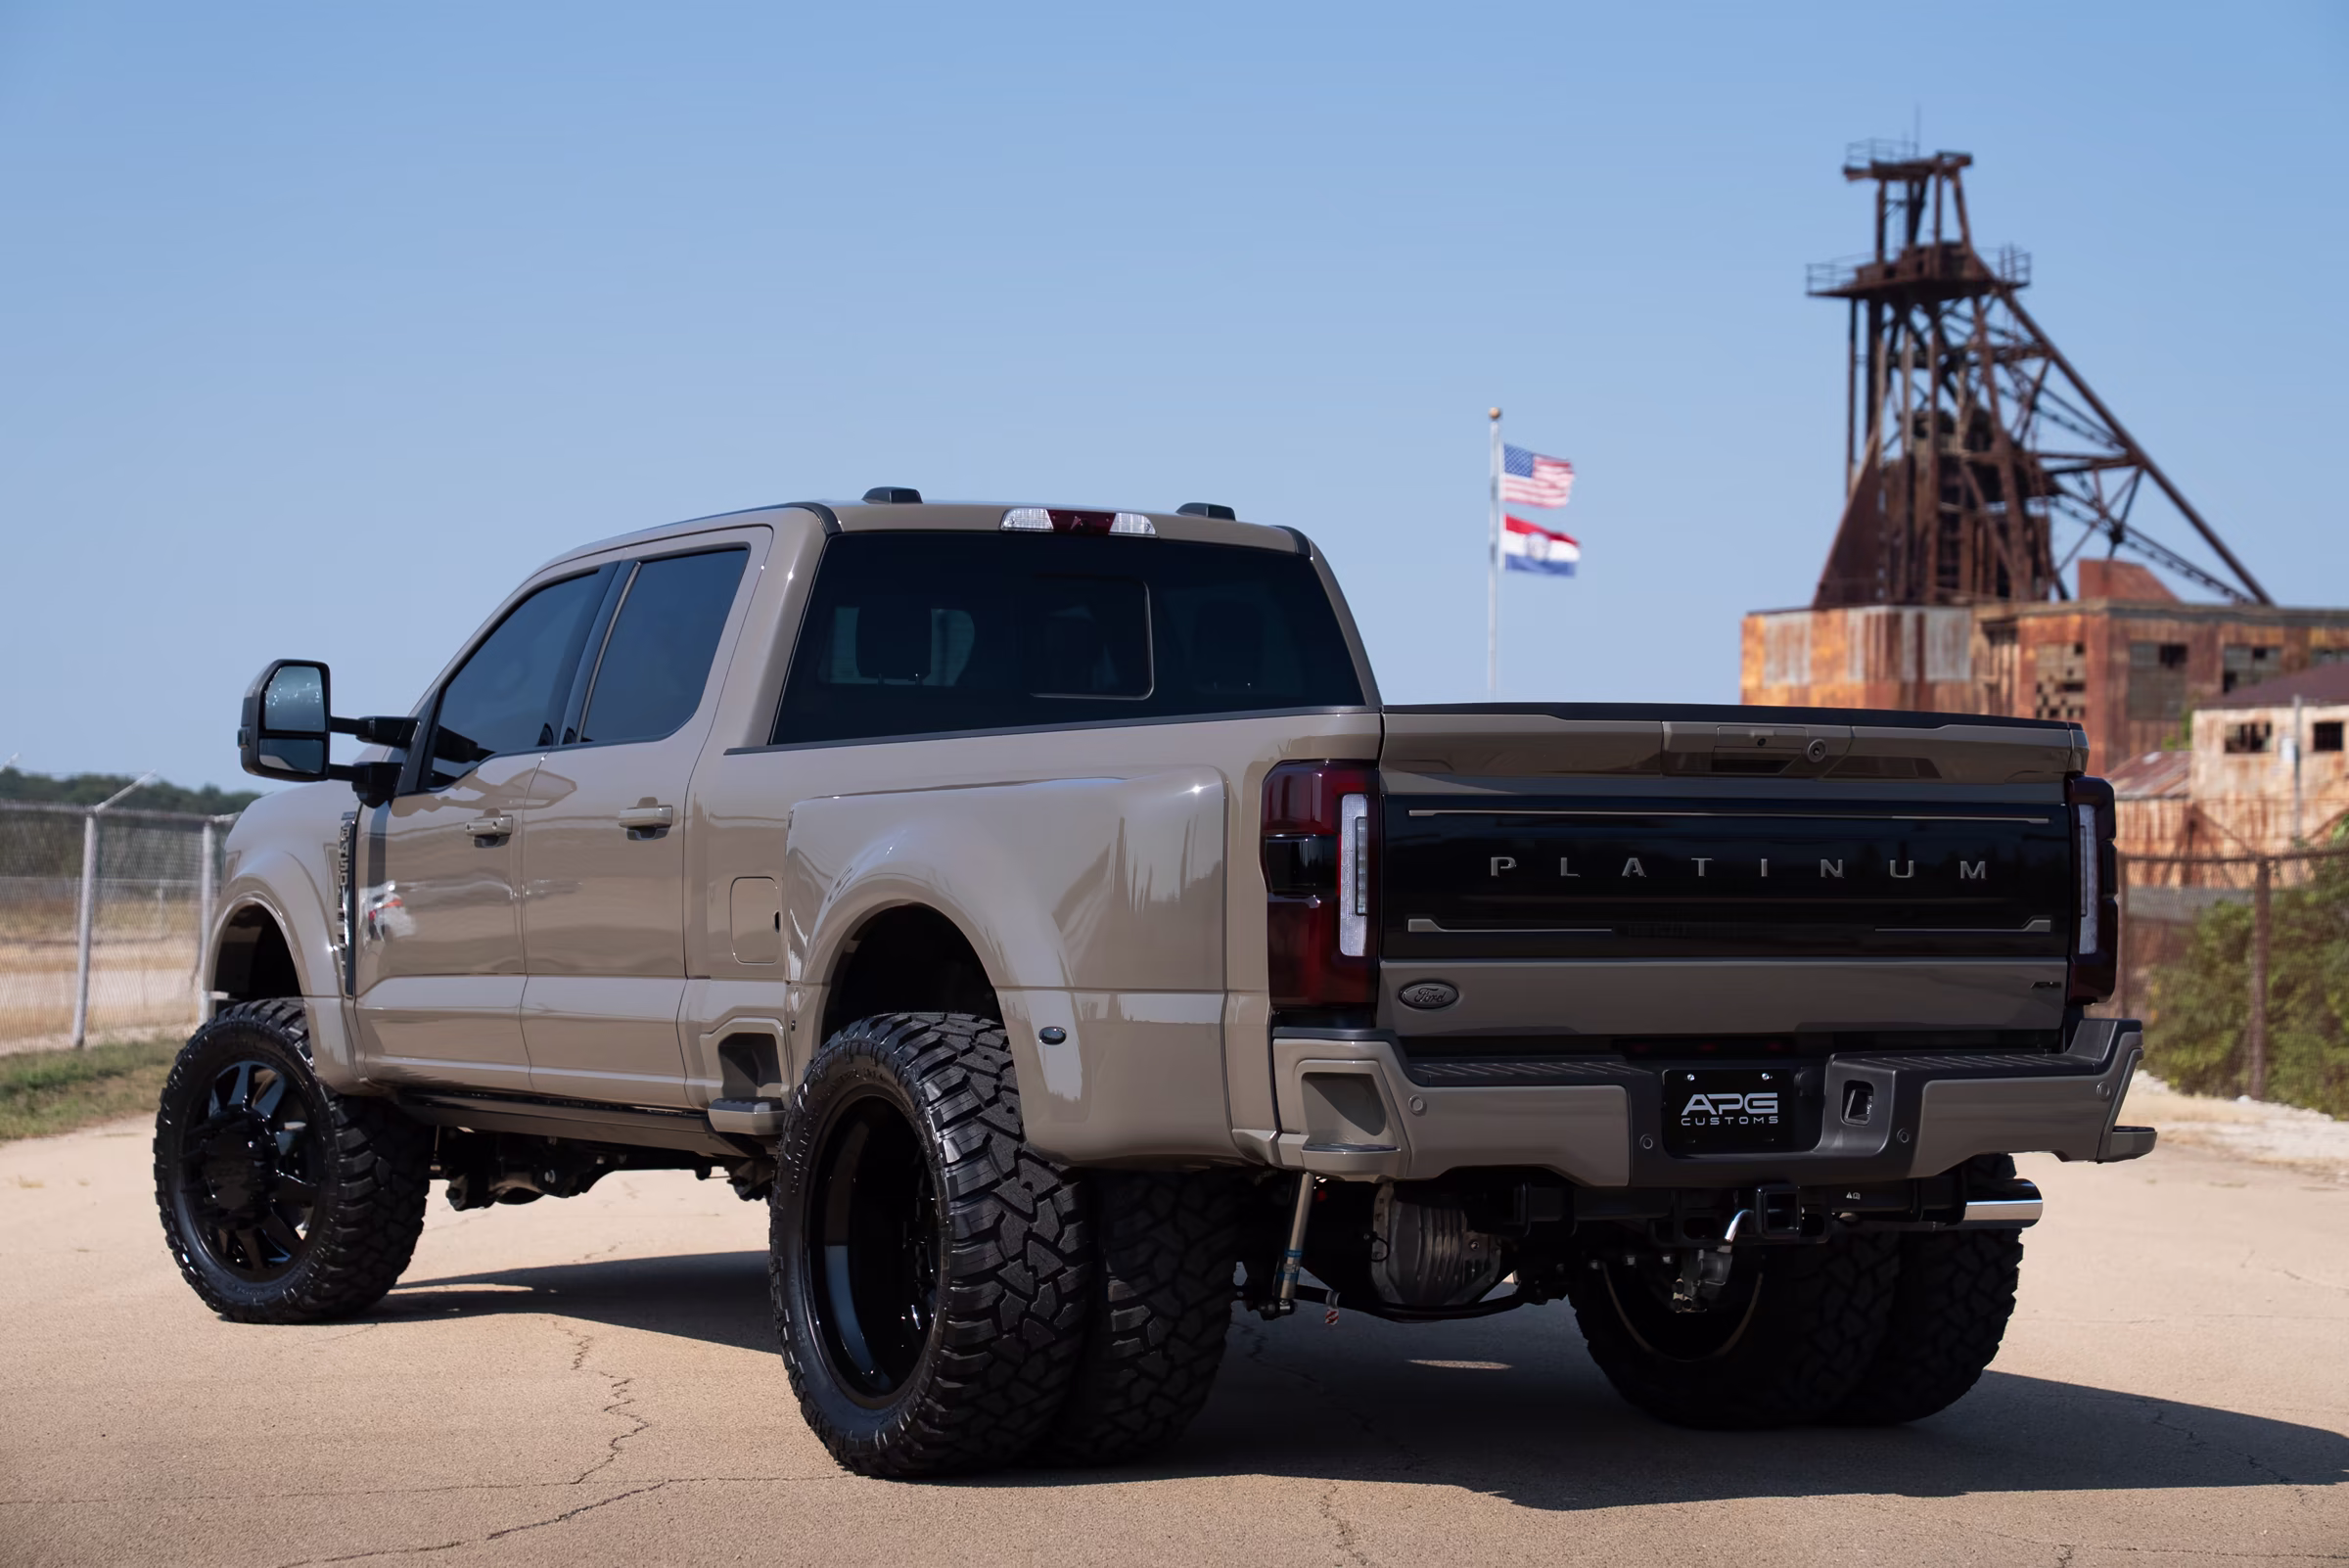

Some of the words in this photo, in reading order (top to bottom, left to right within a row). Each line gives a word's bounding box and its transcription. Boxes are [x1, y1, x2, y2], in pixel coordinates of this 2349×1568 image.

[1490, 856, 1986, 880] PLATINUM
[1413, 987, 1447, 1003] Ford
[1681, 1092, 1778, 1116] APG
[1681, 1116, 1779, 1127] CUSTOMS
